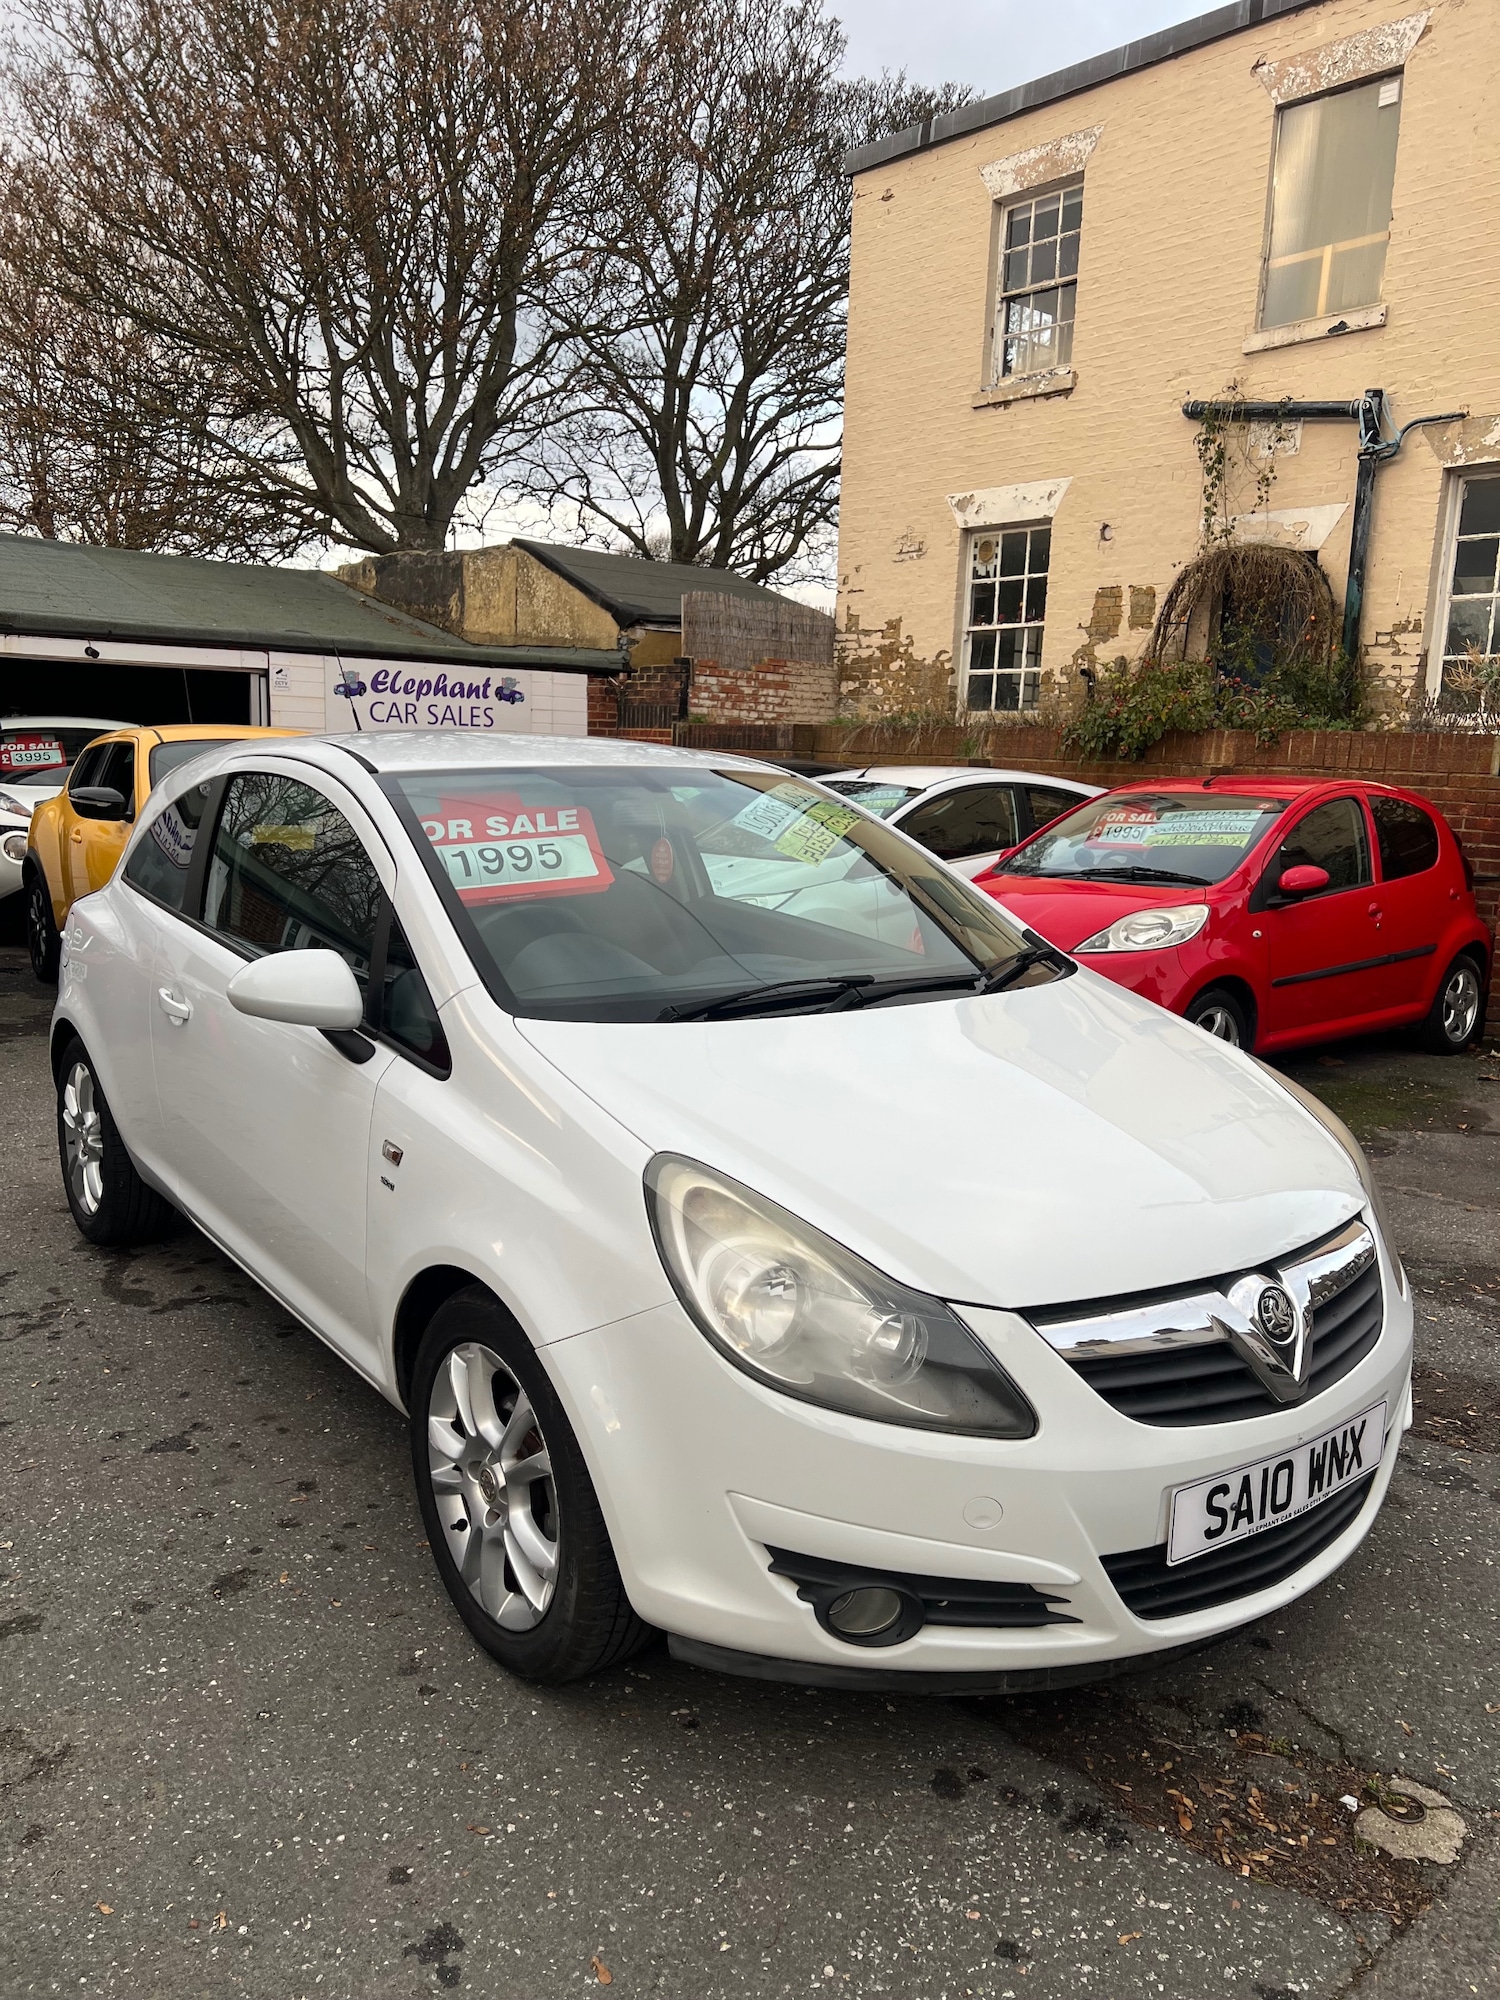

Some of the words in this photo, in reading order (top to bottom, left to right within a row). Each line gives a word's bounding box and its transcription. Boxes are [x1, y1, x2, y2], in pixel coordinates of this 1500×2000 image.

[370, 669, 491, 702] Elephant
[369, 701, 418, 724] CAR
[427, 704, 494, 727] SALES
[0, 743, 25, 751] FOR
[29, 742, 59, 750] SALE
[1, 753, 10, 764] £
[15, 752, 51, 762] 3995
[421, 819, 474, 842] OR
[485, 809, 580, 836] SALE
[1100, 812, 1127, 822] FOR
[1105, 826, 1143, 839] 1995
[450, 842, 563, 878] 1995
[1204, 1458, 1294, 1540] SA10
[1308, 1419, 1366, 1499] WNX
[1248, 1517, 1280, 1535] ELEPHANT
[1280, 1512, 1292, 1522] CAR
[1293, 1503, 1309, 1514] SALES
